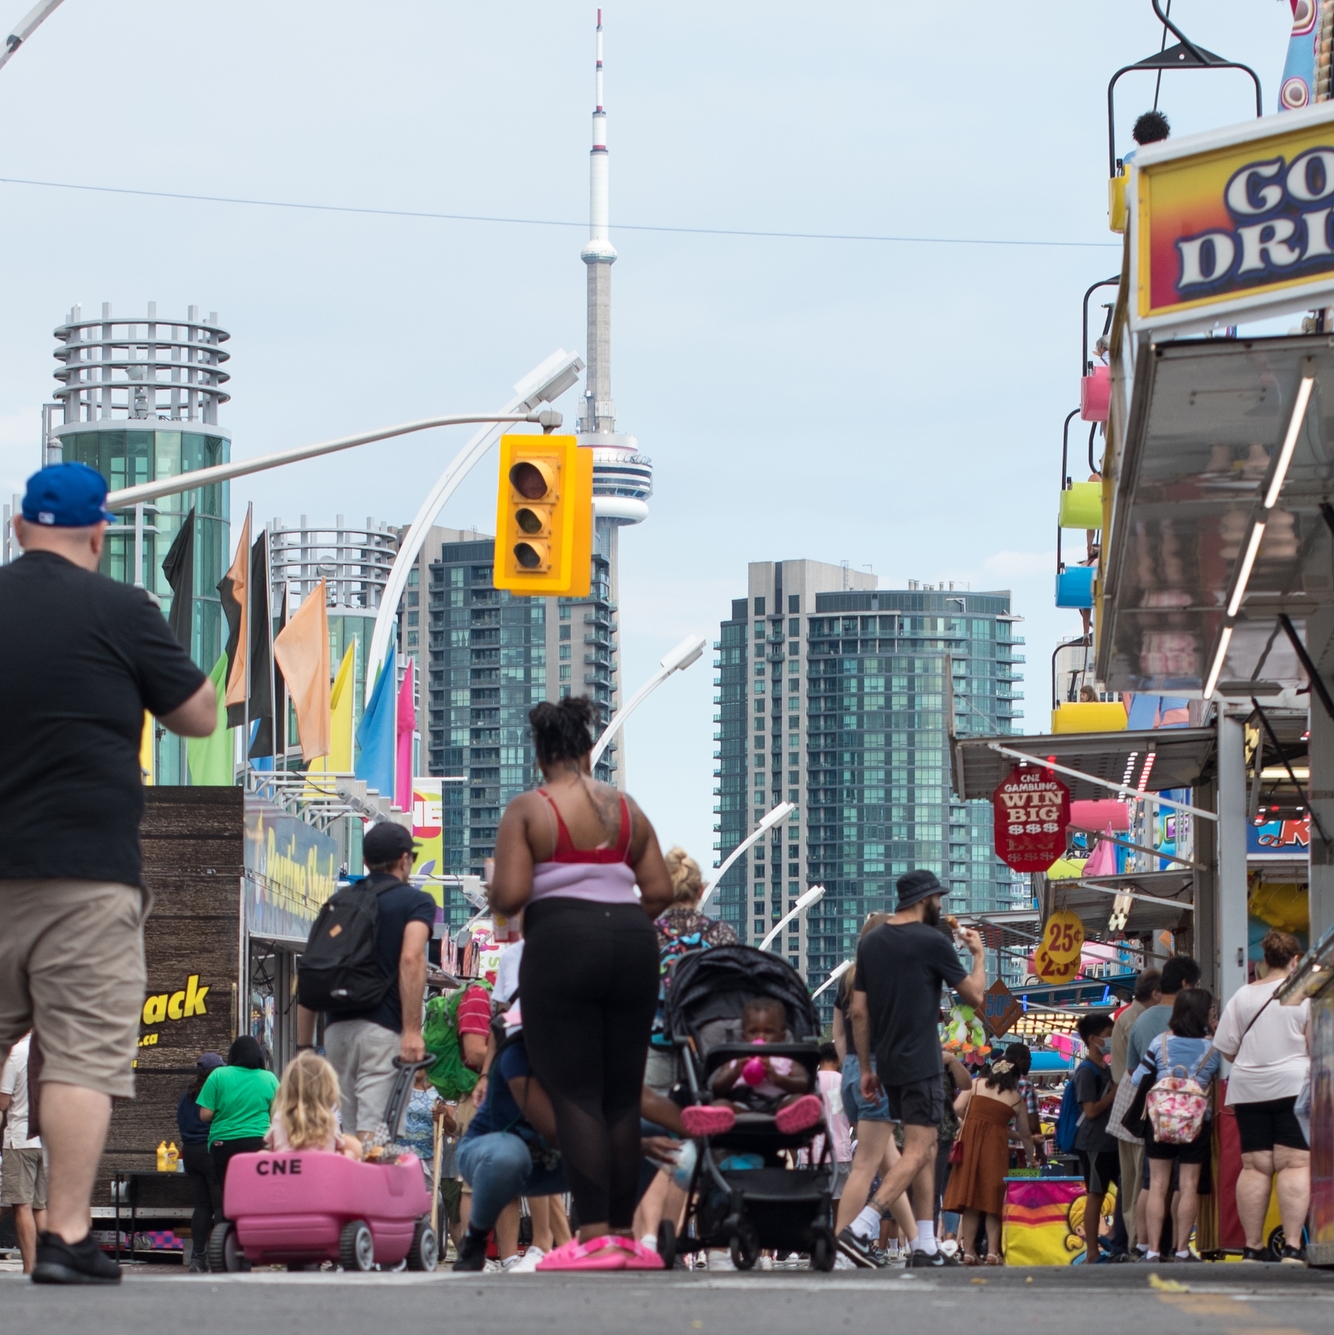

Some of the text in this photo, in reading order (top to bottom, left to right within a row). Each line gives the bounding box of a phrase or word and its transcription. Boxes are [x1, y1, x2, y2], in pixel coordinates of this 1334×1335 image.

[1020, 774, 1040, 783] CNE
[1004, 782, 1057, 792] GAMBLING
[1000, 791, 1064, 807] WIN
[1007, 807, 1059, 822] BIG
[1049, 923, 1081, 952] 25¢
[139, 974, 210, 1025] ack
[256, 1159, 302, 1176] CNE
